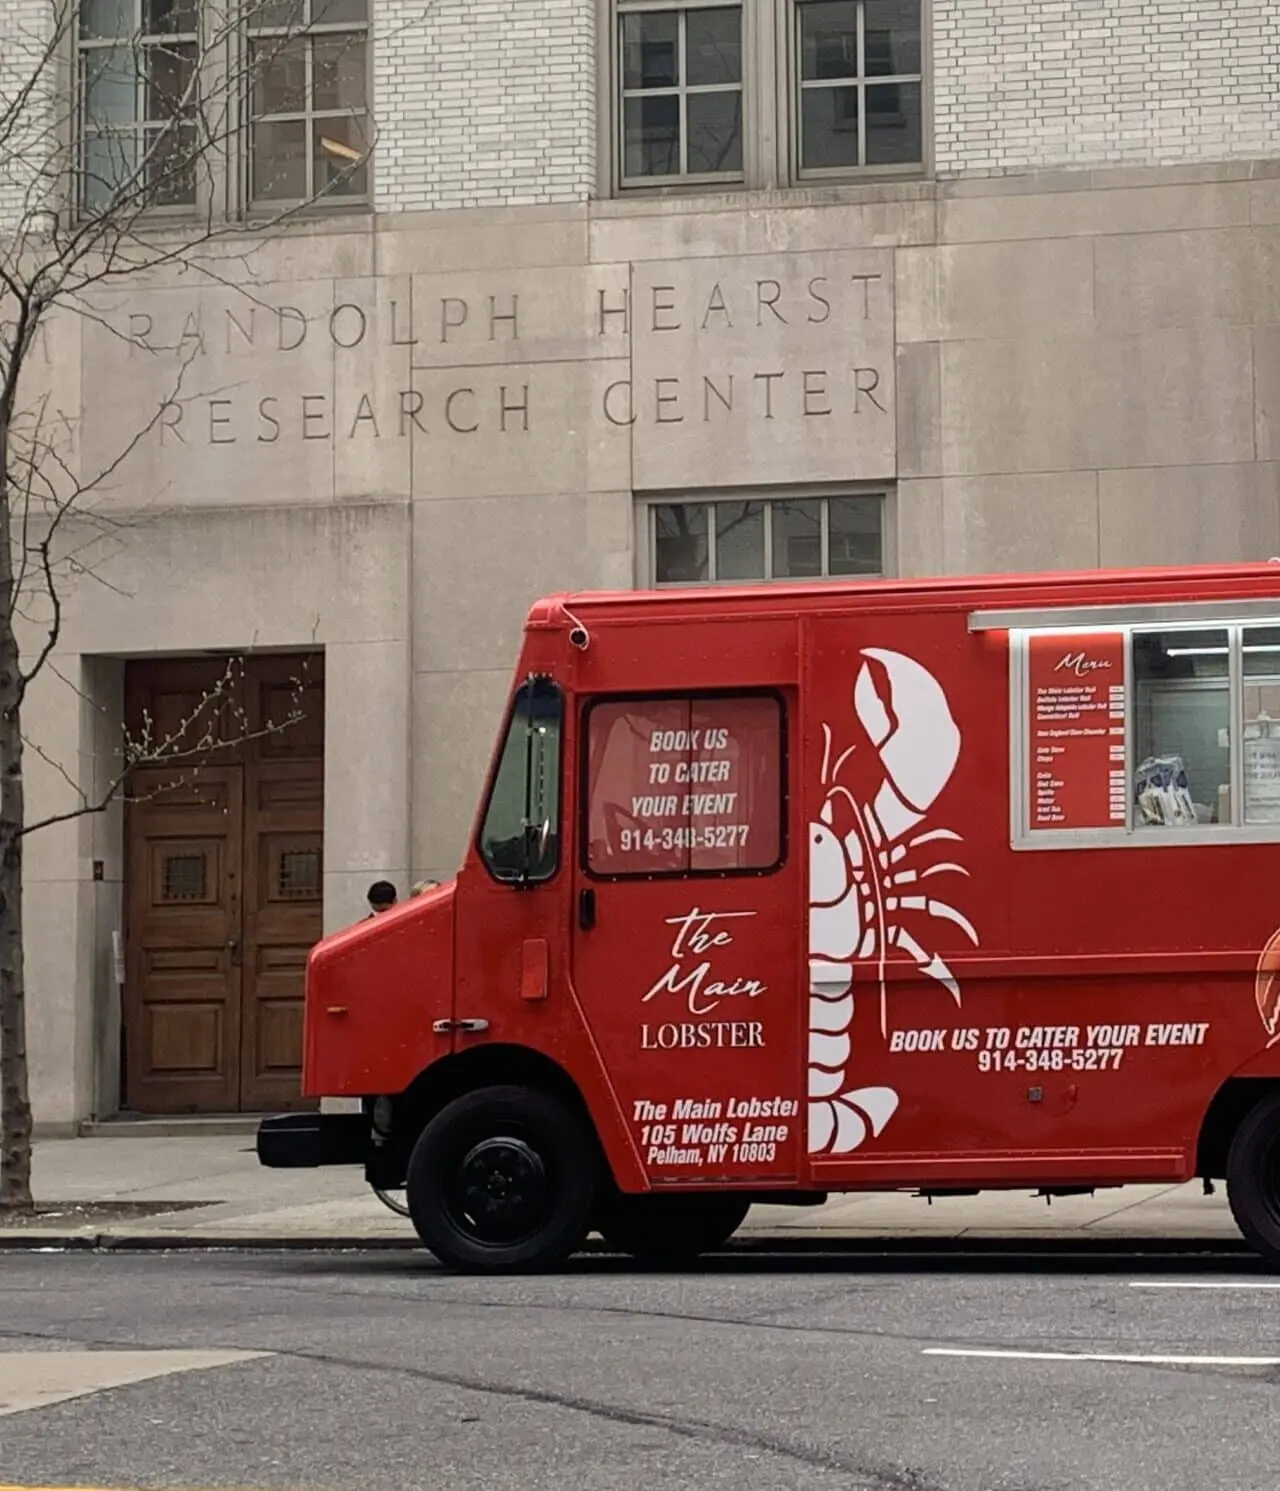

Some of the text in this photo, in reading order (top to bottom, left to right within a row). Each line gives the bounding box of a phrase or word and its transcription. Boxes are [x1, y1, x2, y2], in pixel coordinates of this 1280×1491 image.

[128, 274, 882, 357] RANDOLPH HEARST
[158, 367, 888, 446] RESEARCH CENTER
[1054, 652, 1113, 677] Menu
[650, 728, 729, 752] BOOK US
[649, 761, 731, 784] TO CATER
[632, 793, 737, 818] YOUR EVENT
[620, 825, 750, 851] 914-348-5277
[641, 962, 769, 1014] Main
[641, 1022, 766, 1049] LOBSTER
[889, 1023, 1209, 1052] BOOK US TO CATER YOUR EVENT
[978, 1049, 1124, 1072] 914-348-5277
[633, 1100, 667, 1121] The
[672, 1098, 721, 1119] Main
[641, 1122, 788, 1146] 105 Wolfs Lane
[647, 1142, 776, 1167] Pelham, NY 10803
